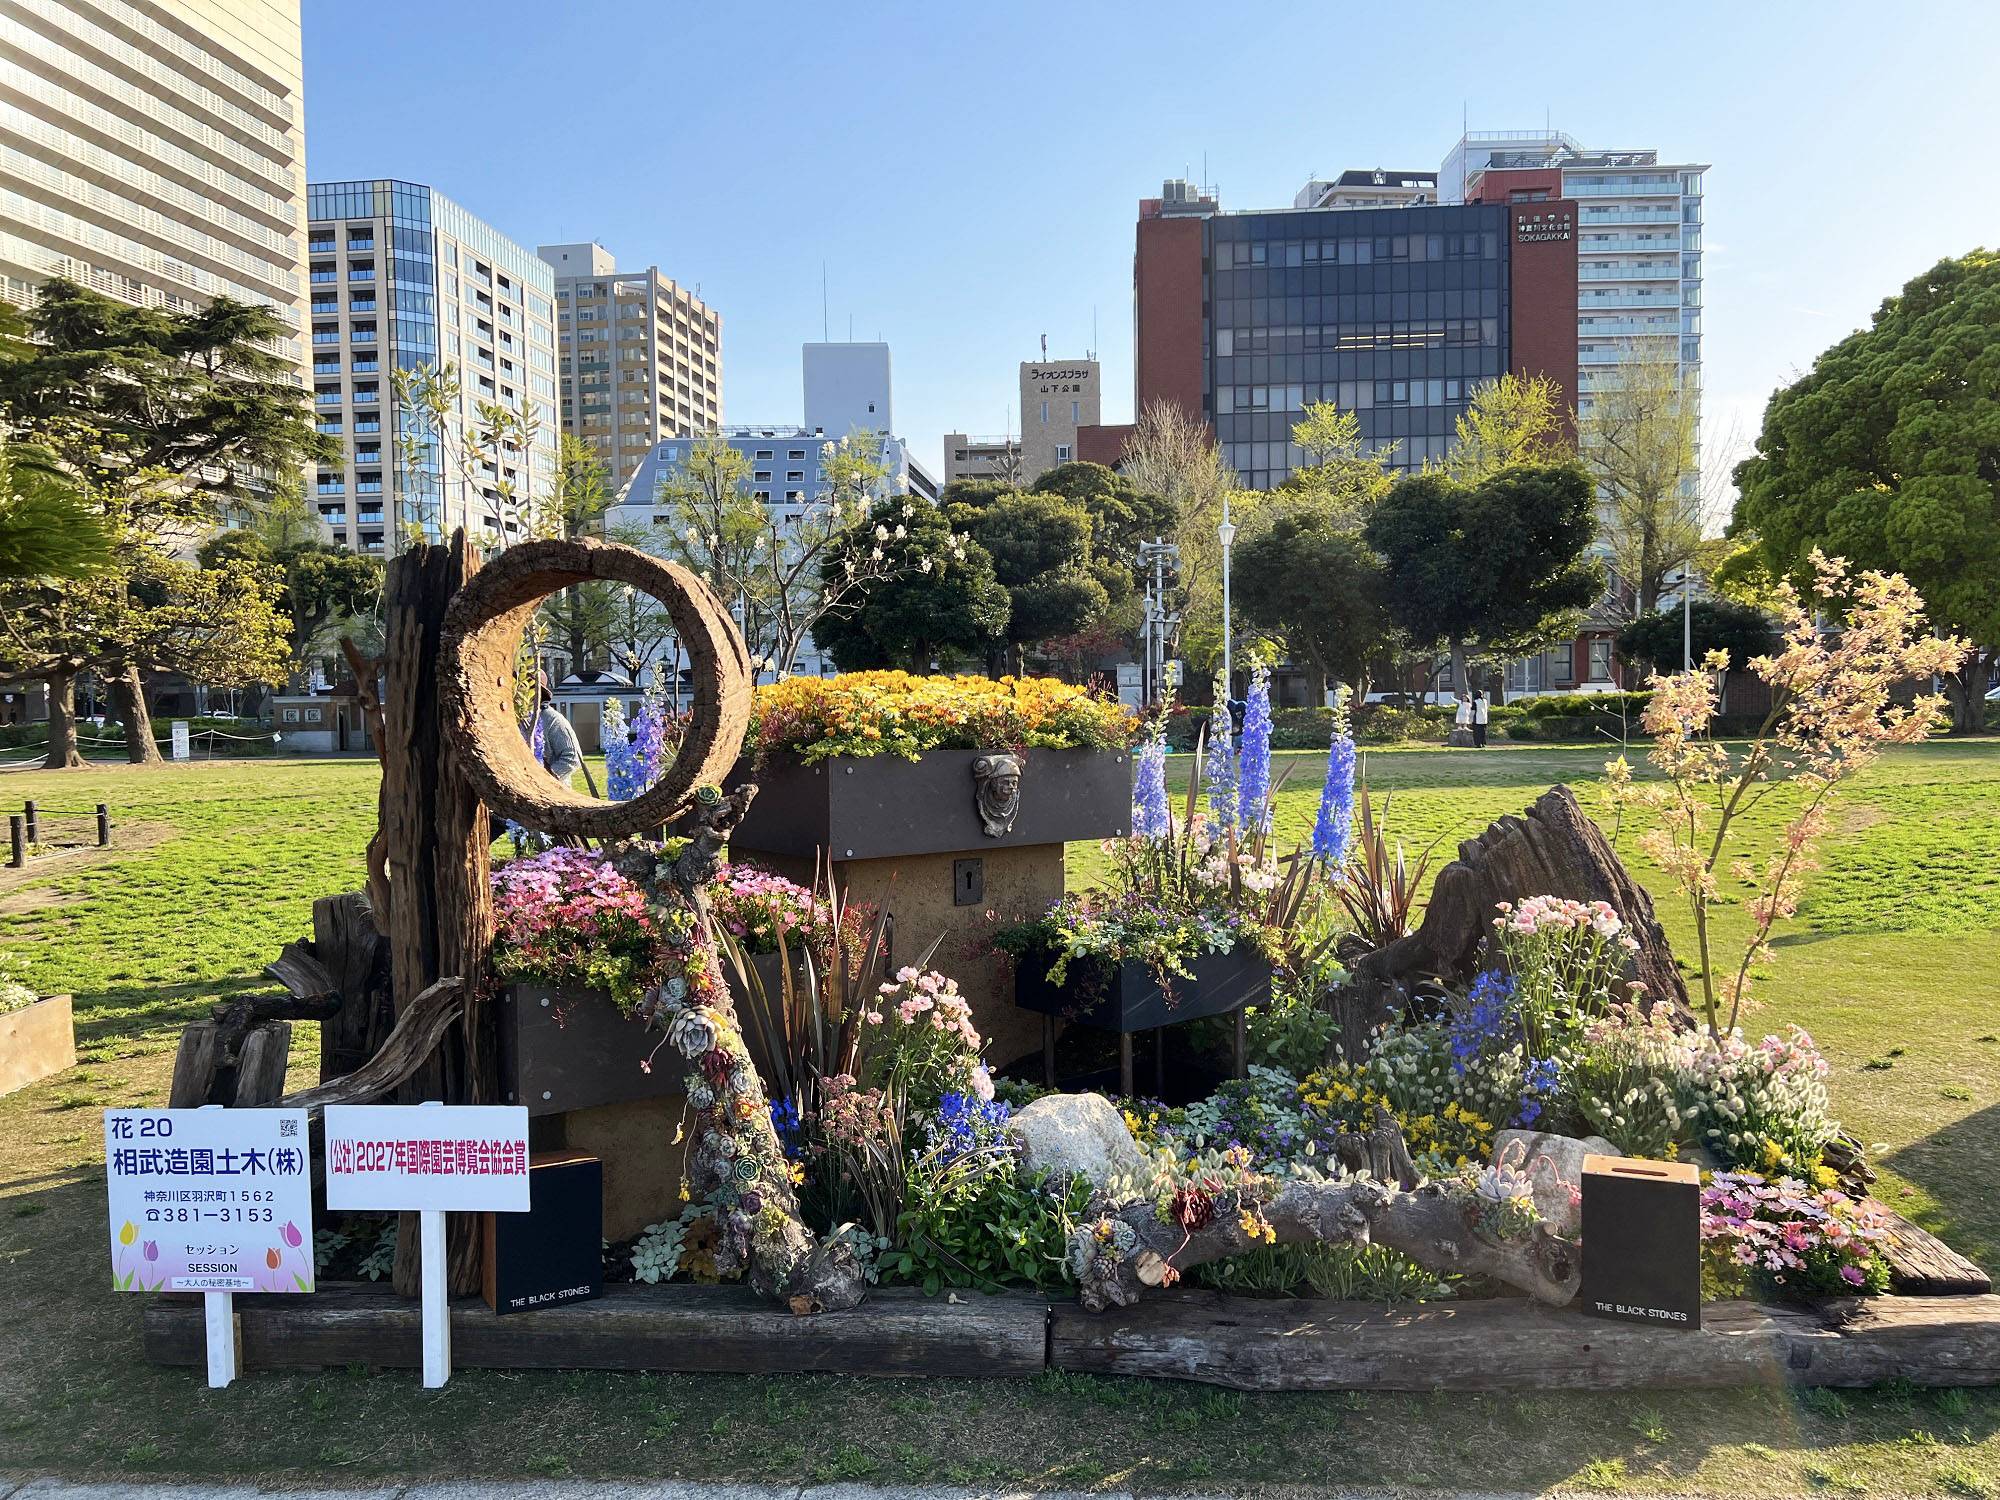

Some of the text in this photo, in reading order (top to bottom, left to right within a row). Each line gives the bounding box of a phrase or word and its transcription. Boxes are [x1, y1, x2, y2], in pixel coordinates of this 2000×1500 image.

[1518, 232, 1571, 242] SOKAGAKKAI
[1040, 384, 1080, 393] 山下公園
[111, 1117, 173, 1139] 花 20
[113, 1147, 304, 1176] 相武造園土木(株)
[143, 1190, 274, 1203] 神奈川区羽沢町1562
[185, 1244, 240, 1255] セッション
[188, 1263, 238, 1273] SESSION
[510, 1286, 590, 1307] THE BLACK STONES
[1595, 1302, 1688, 1321] THE BLACK STONES
